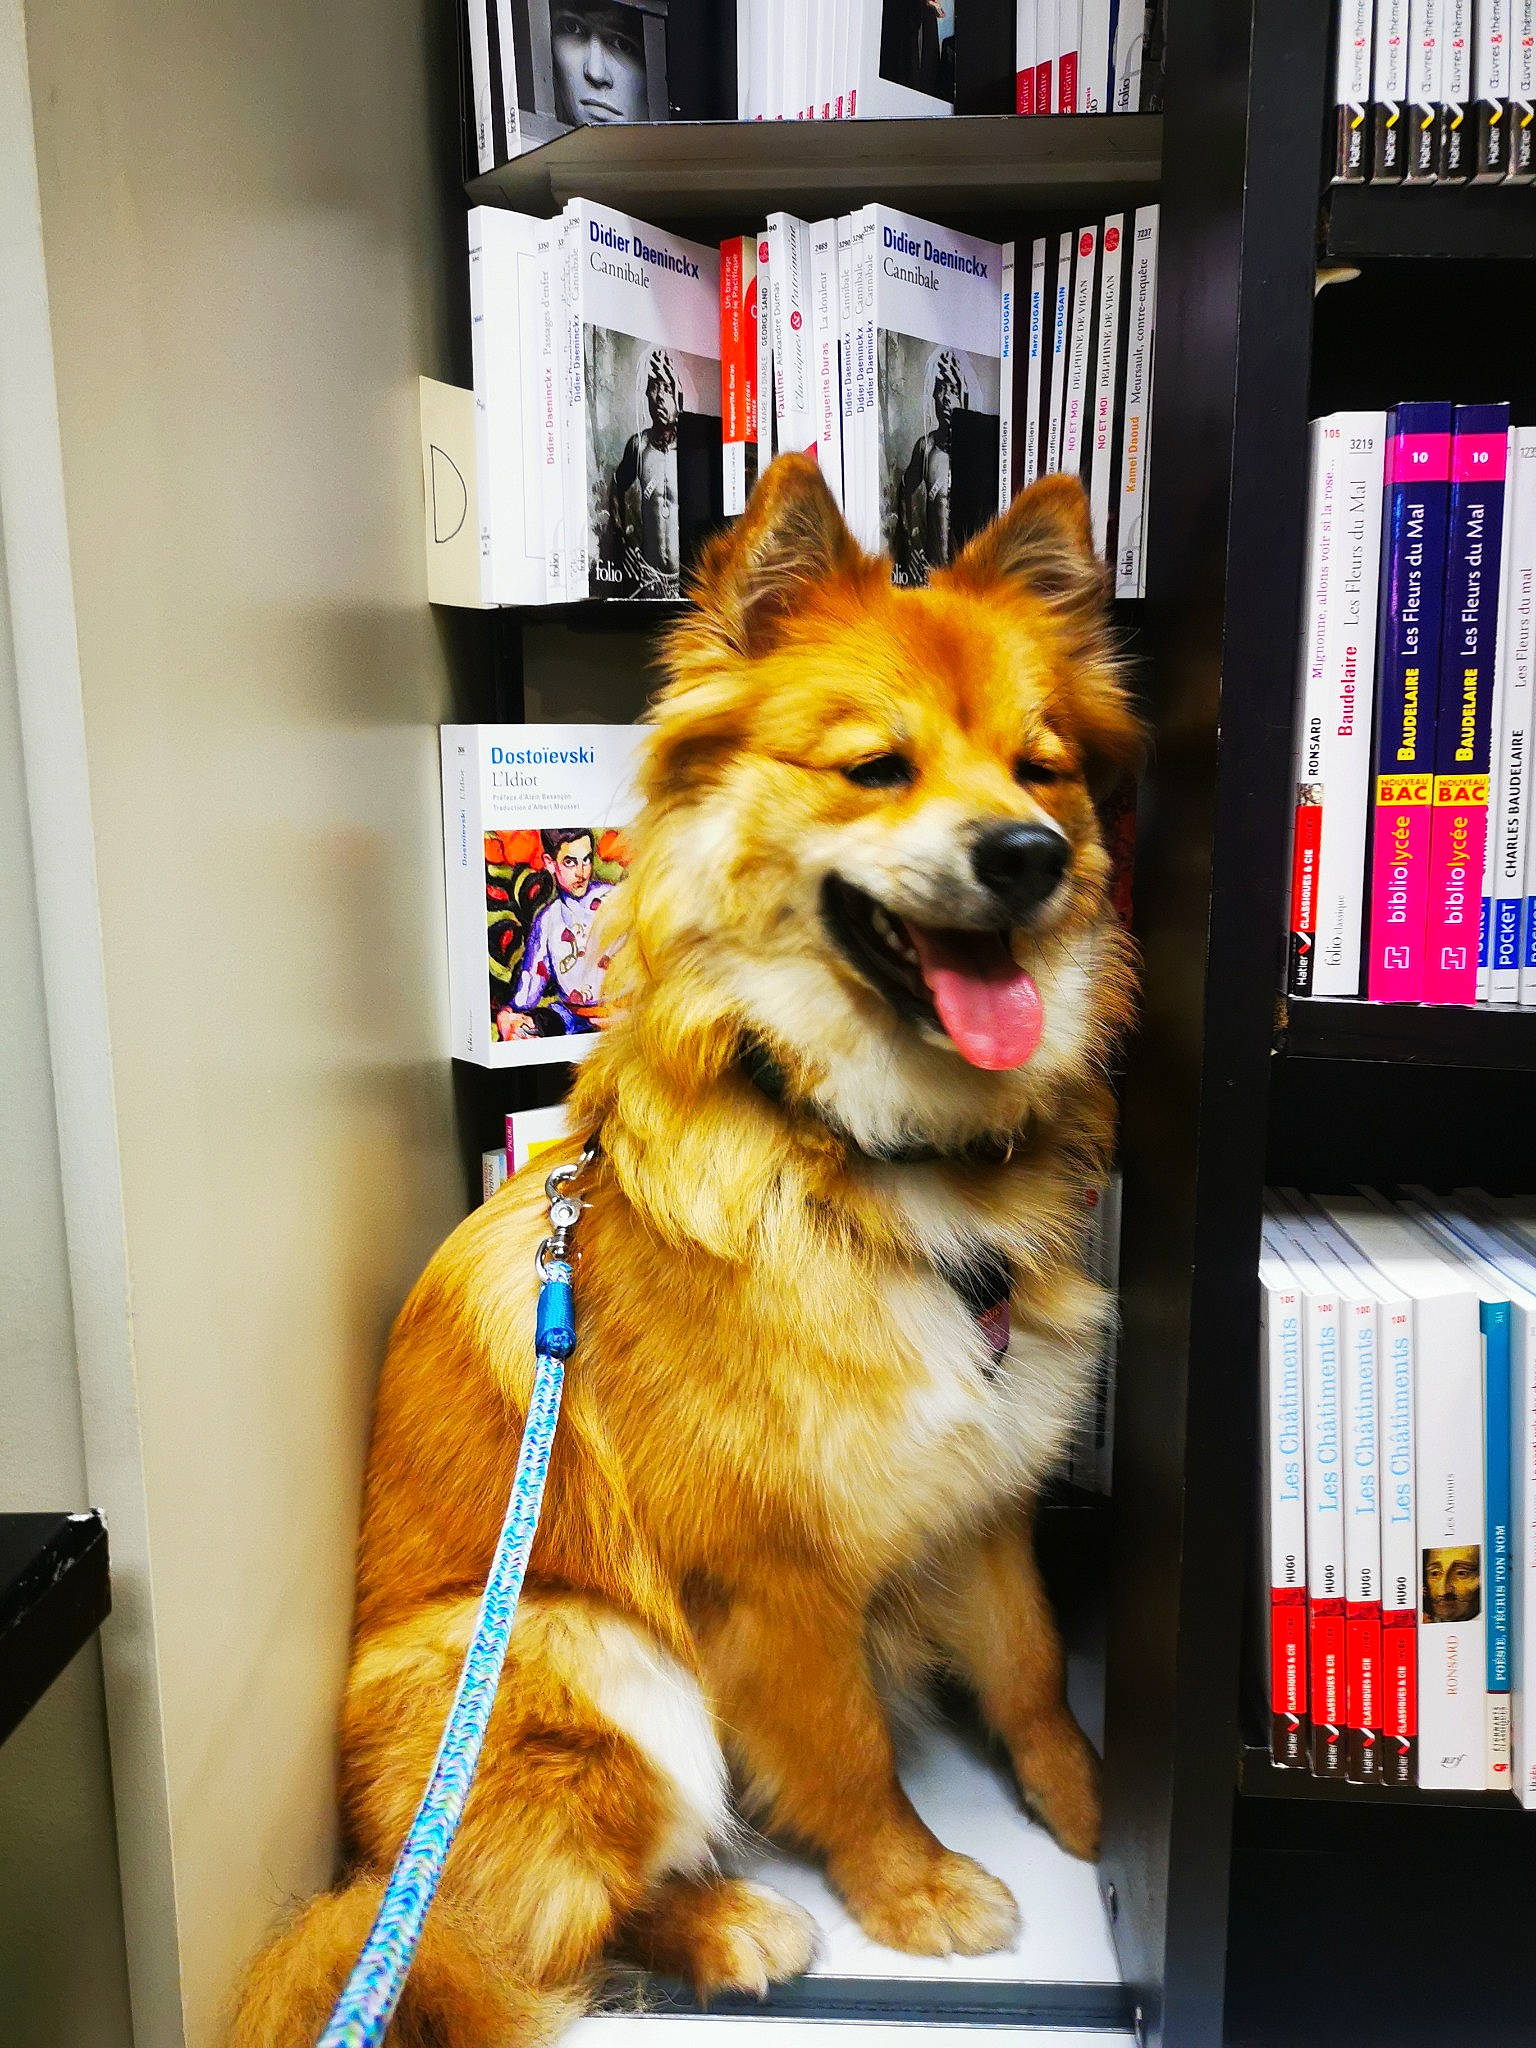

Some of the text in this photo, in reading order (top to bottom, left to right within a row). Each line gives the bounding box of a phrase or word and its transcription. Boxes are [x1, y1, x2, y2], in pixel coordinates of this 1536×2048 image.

[1118, 78, 1130, 106] folio
[589, 220, 699, 280] Didier Daeninckx
[883, 226, 988, 279] Didier Daeninckx
[590, 251, 650, 289] Cannibale
[883, 257, 940, 291] Cannibale
[1055, 287, 1065, 353] Marc DUGAIN
[820, 343, 829, 375] Duras
[843, 333, 851, 385] Daeninckx
[855, 328, 864, 380] Daeninckx
[865, 320, 873, 373] Daeninckx
[1098, 275, 1115, 450] NO ET MOI DELPHINE DE VIGAN
[1068, 279, 1088, 451] NO ET MOI DELPHINE DE VIGAN
[775, 370, 785, 418] Pauline
[820, 379, 833, 441] Marguerite
[844, 388, 852, 417] Didier
[856, 384, 864, 413] Didier
[1122, 259, 1150, 576] folio Kamel Daoud Meursault, contre-enquête
[1324, 429, 1341, 438] 105
[1350, 439, 1373, 450] 3219
[1412, 452, 1428, 463] 10
[1472, 452, 1488, 463] 10
[1322, 505, 1333, 515] la
[1350, 480, 1367, 512] Mal
[1321, 522, 1331, 532] si
[1348, 520, 1366, 540] du
[1319, 536, 1330, 561] voir
[596, 559, 623, 583] folio
[1317, 566, 1329, 605] allons
[1345, 546, 1364, 593] Fleurs
[1519, 568, 1532, 592] mal
[1344, 600, 1360, 626] Les
[1517, 595, 1530, 614] du
[1397, 504, 1425, 761] BAUDELAIRE Les Fleurs du Mal
[1456, 504, 1484, 761] BAUDELAIRE Les Fleurs du Mal
[1515, 618, 1529, 660] Fleurs
[1338, 646, 1358, 736] Baudelaire
[1514, 665, 1526, 688] Les
[491, 746, 594, 764] Dostoïevski
[1308, 718, 1321, 775] RONSARD
[491, 771, 538, 788] L'Idiot
[1439, 779, 1485, 787] NOUVEAU
[1506, 729, 1524, 815] BAUDELAIRE
[1381, 786, 1427, 800] BAC
[1439, 786, 1485, 800] BAC
[1304, 849, 1313, 863] CIE
[1504, 818, 1519, 878] CHARLES
[1388, 816, 1414, 924] bibliolycée
[1444, 816, 1471, 924] bibliolycée
[1300, 875, 1312, 929] CLASSIQUES
[1298, 956, 1309, 985] Hatier
[1325, 937, 1343, 968] folio
[1278, 1318, 1299, 1455] Châtiments
[1315, 1327, 1338, 1592] HUGO Les Châtiments
[1352, 1328, 1376, 1596] HUGO Les Châtiments
[1388, 1337, 1411, 1604] HUGO Les Châtiments
[1280, 1463, 1300, 1501] Les
[1495, 1525, 1506, 1552] NOM
[1286, 1555, 1296, 1582] HUGO
[1495, 1555, 1506, 1580] TON
[1447, 1635, 1457, 1695] RONSARD
[1492, 1633, 1509, 1680] POÉSIE,
[1288, 1733, 1298, 1758] Hatier
